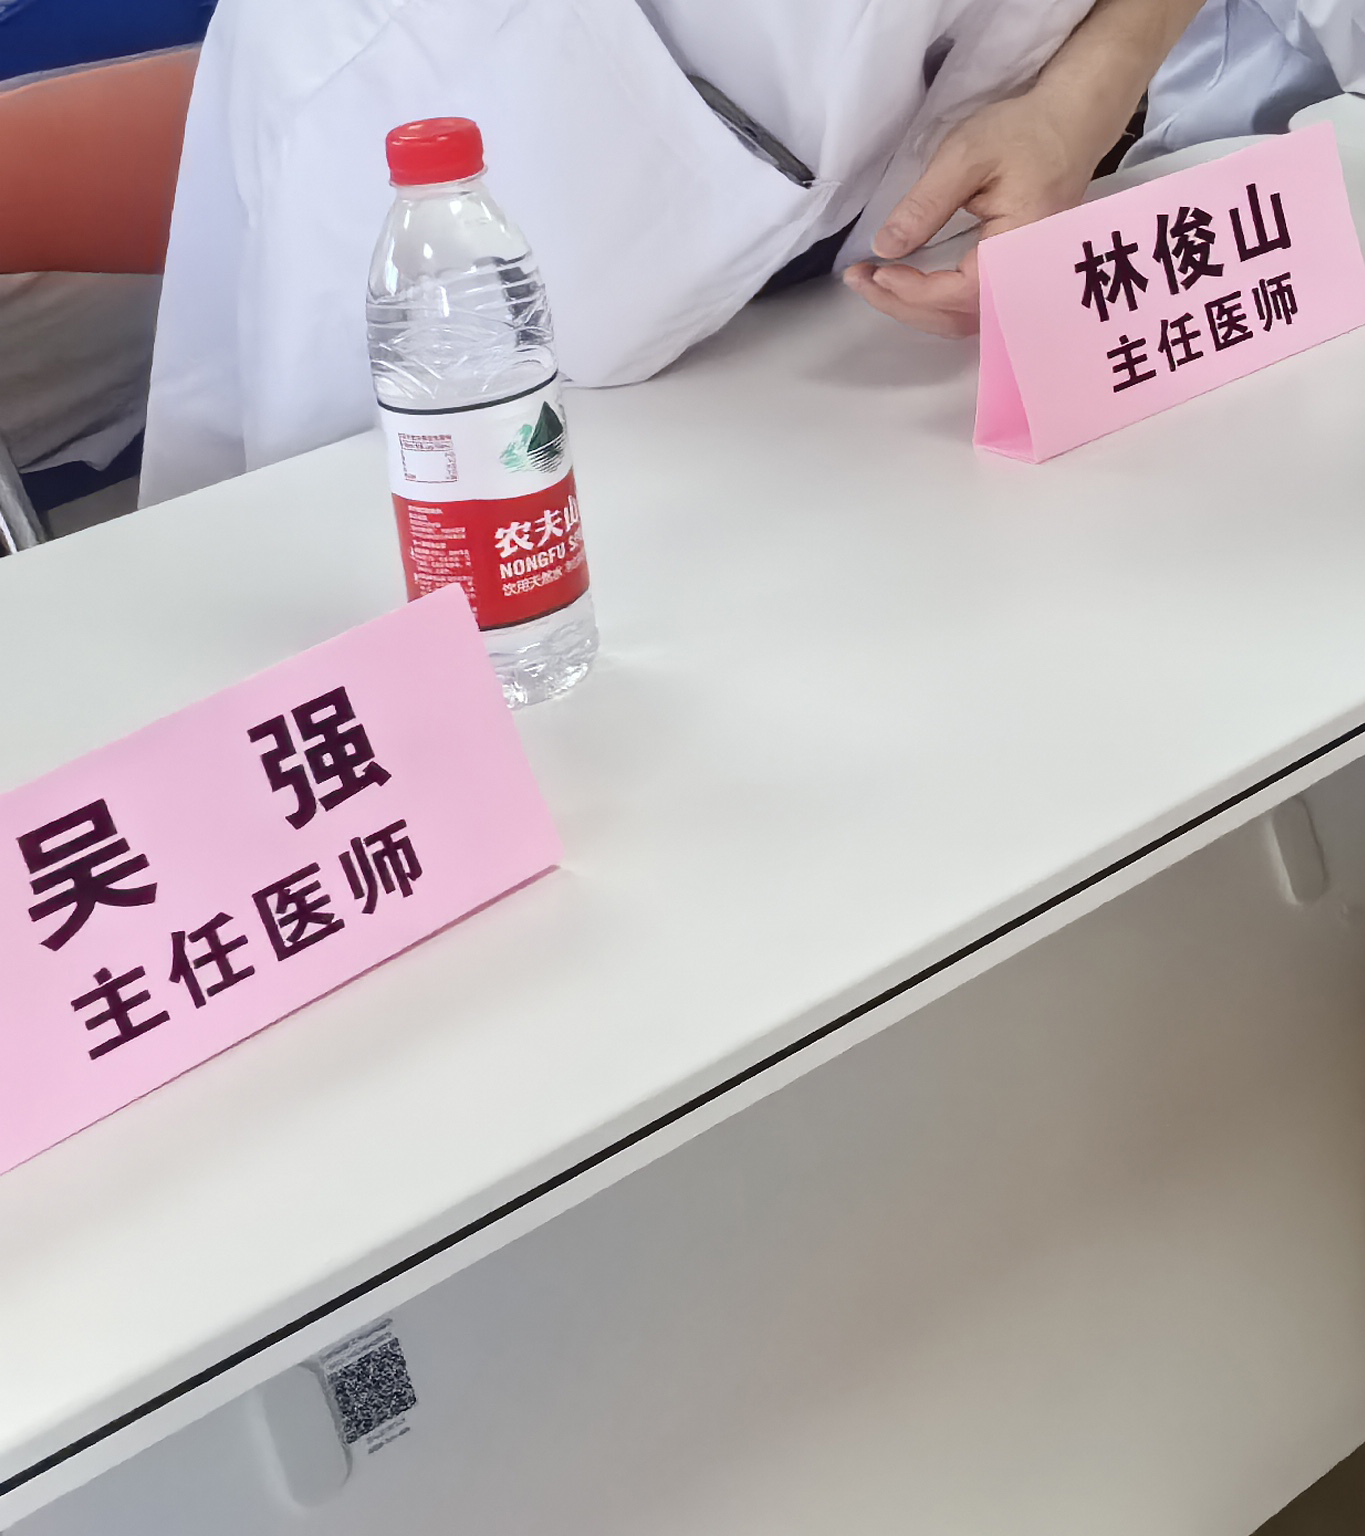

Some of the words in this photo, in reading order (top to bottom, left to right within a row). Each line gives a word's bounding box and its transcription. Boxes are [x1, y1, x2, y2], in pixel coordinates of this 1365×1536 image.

[1075, 183, 1291, 322] 林俊山
[1107, 272, 1298, 393] 主任医师
[500, 541, 566, 579] NONGFU
[71, 820, 422, 1061] 主任医师
